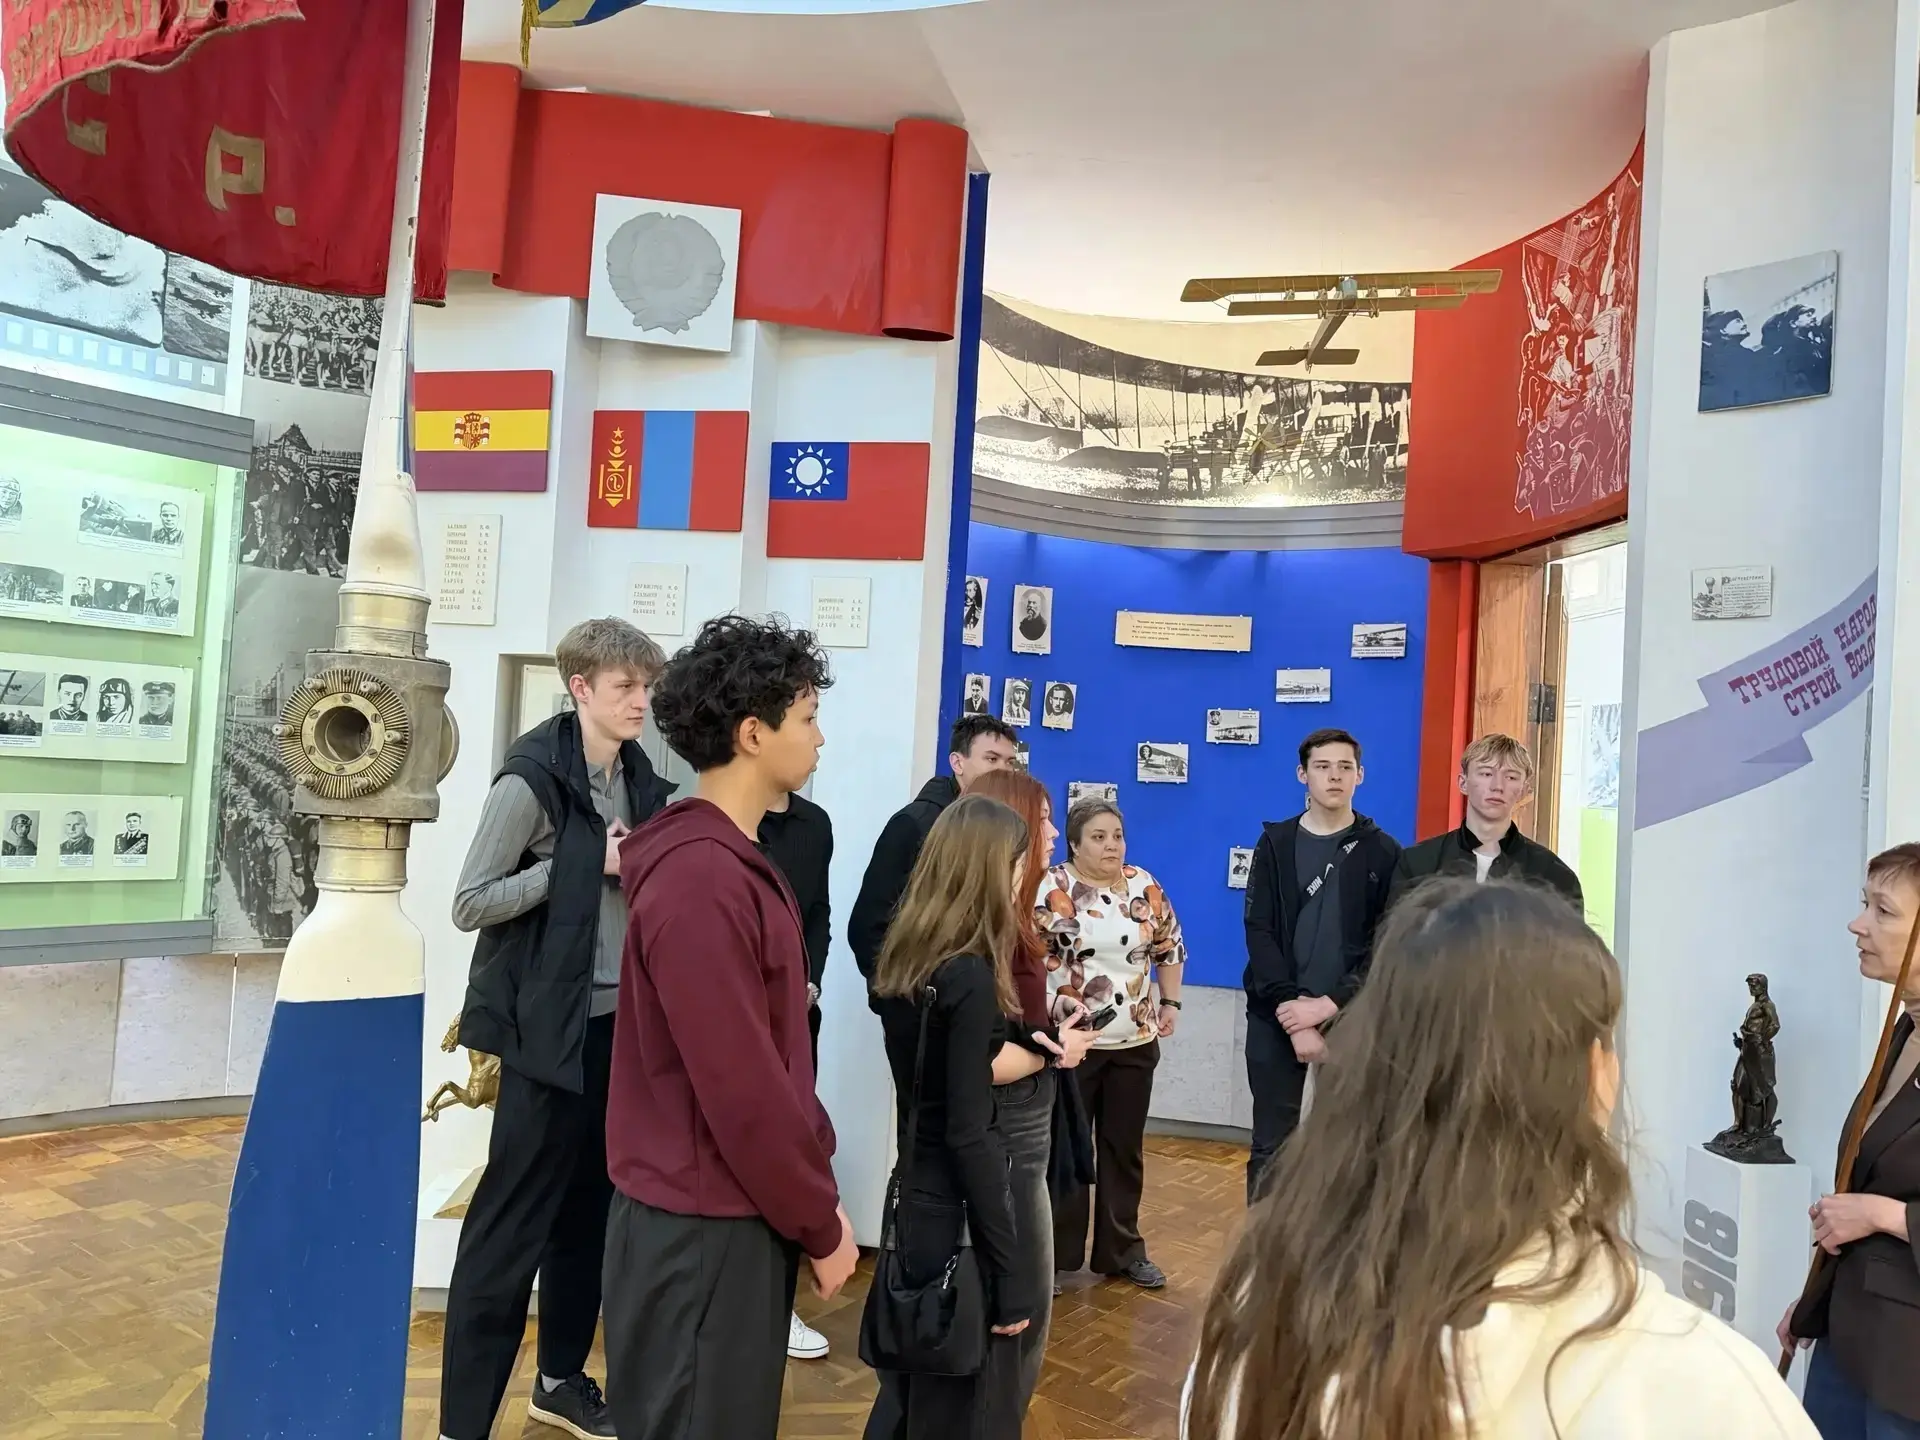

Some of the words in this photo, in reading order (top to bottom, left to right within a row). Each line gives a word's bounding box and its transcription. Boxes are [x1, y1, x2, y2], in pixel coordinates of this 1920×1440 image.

[1728, 634, 1830, 704] ТРУДОВОЙ
[1783, 664, 1841, 716] СТРОЙ
[1306, 876, 1323, 896] NIKE
[1682, 1199, 1738, 1322] 918
